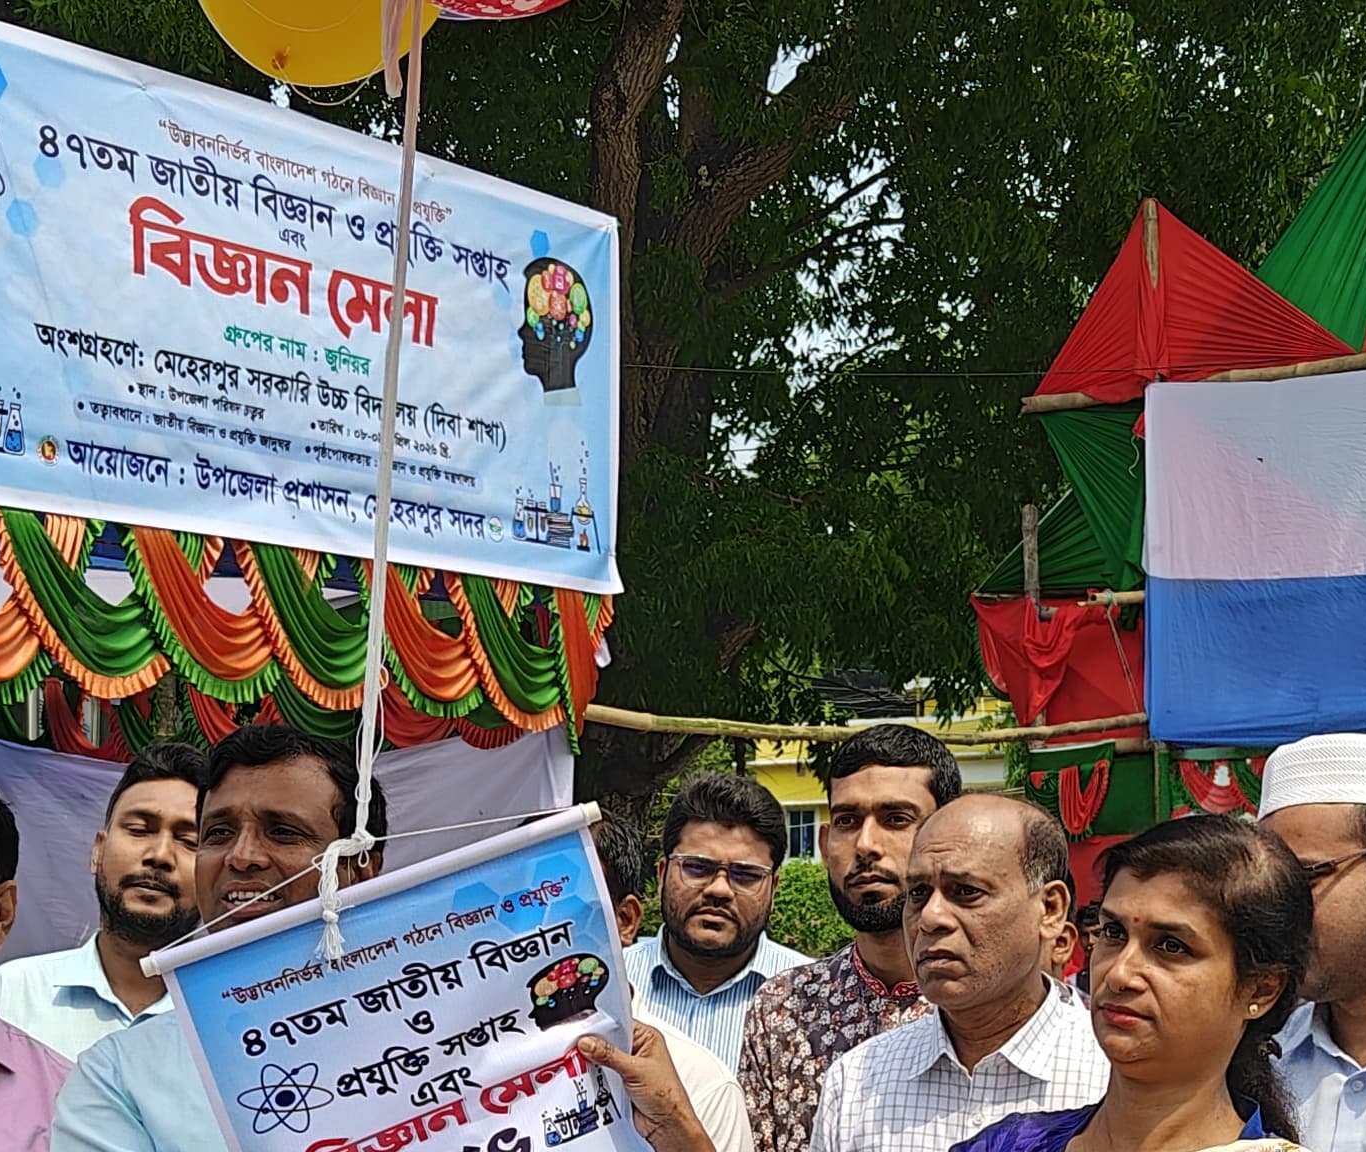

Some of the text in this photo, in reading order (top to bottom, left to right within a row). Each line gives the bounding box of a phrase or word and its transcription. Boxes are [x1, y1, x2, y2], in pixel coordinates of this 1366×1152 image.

[39, 124, 139, 183] ৪৭তম
[146, 155, 244, 213] জাতীয়
[249, 173, 337, 237] বিজ্ঞান
[345, 212, 366, 242] ও
[450, 242, 512, 293] সপ্তাহ
[256, 150, 317, 184] বাংলাদেশ
[321, 166, 353, 193] গঠনে
[358, 176, 396, 207] বিজ্ঞান
[128, 195, 313, 316] বিজ্ঞান
[279, 228, 307, 251] এবং
[223, 324, 274, 353] গ্রুপের
[279, 337, 307, 362] নাম
[154, 349, 240, 394] মেহেরপুর
[246, 367, 312, 406] সরকারি
[317, 378, 350, 412] উচ্চ
[423, 402, 461, 440] (দিবা
[465, 416, 507, 453] শাখা)
[168, 385, 209, 409] উপজেলা
[219, 427, 226, 439] ও
[66, 440, 171, 487] আয়োজনে
[193, 453, 277, 504] উপজেলা
[283, 478, 357, 523] প্রশাসন,
[447, 507, 486, 538] সদর
[326, 937, 400, 975] বাংলাদেশ
[402, 922, 445, 949] গঠনে
[446, 904, 497, 935] বিজ্ঞান
[499, 899, 516, 914] ও
[242, 920, 575, 1058] ৪৭তম জাতীয় বিজ্ঞান
[404, 1009, 436, 1036] ও
[336, 1008, 527, 1098] প্রযুক্তি সপ্তাহ
[410, 1064, 483, 1108] এবং
[479, 1045, 589, 1115] মেলা
